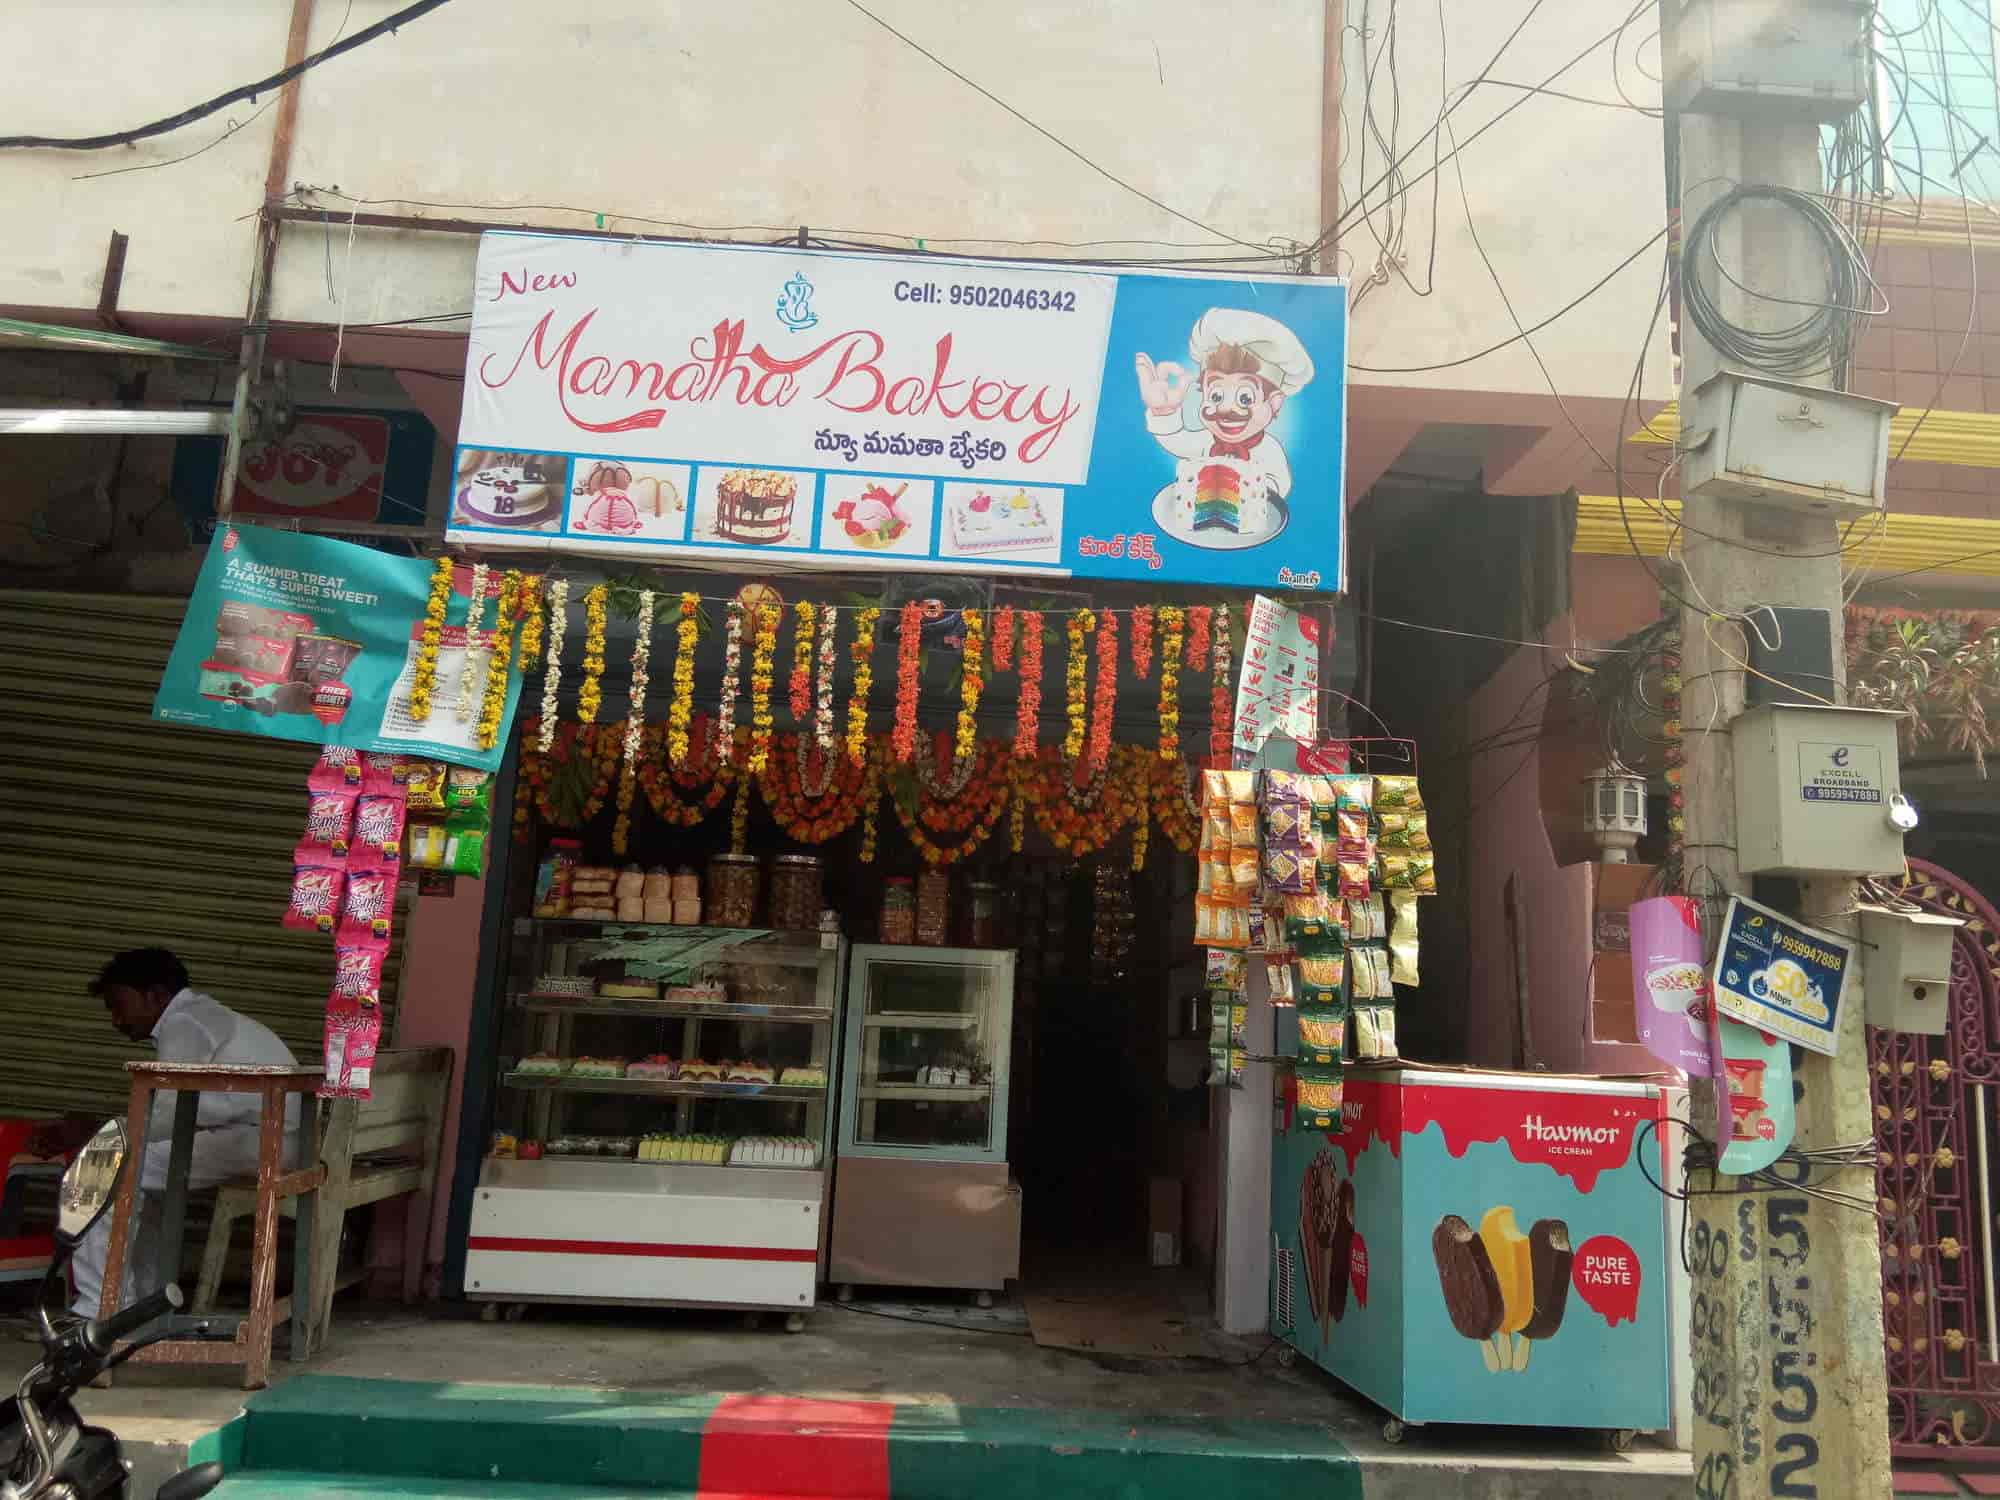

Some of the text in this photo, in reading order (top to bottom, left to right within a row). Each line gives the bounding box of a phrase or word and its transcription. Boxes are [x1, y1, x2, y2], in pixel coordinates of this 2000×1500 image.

[490, 267, 577, 302] New
[894, 279, 1077, 313] Cell: 9502046342
[481, 307, 1080, 464] Mamatha Bakery
[862, 430, 944, 457] మమతా
[225, 567, 277, 588] THAT'S
[279, 579, 319, 596] SUPER
[322, 588, 379, 606] SWEET!
[226, 557, 346, 589] A SUMMER TREAT
[1813, 778, 1871, 788] BROADBAND
[1821, 769, 1862, 778] EXCELL
[1769, 989, 1793, 1006] Mbps
[1520, 1114, 1620, 1144] Havmor
[1547, 1146, 1593, 1157] ICE CREAM
[1585, 1255, 1628, 1271] PURE
[1582, 1269, 1632, 1286] TASTE
